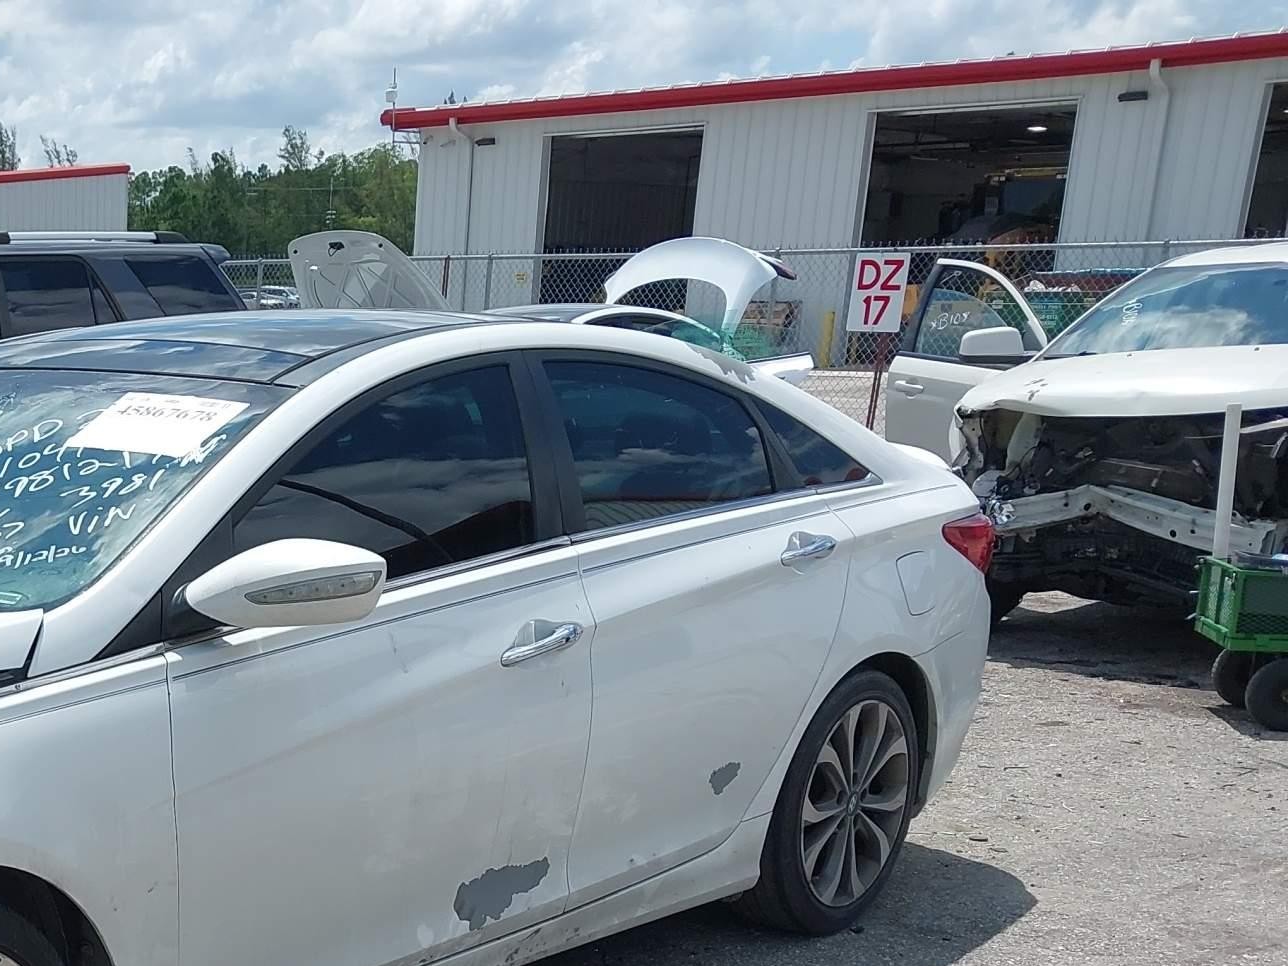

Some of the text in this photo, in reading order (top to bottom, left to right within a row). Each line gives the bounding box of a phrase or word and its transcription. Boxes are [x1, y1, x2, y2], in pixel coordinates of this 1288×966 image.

[857, 259, 905, 290] DZ
[862, 295, 891, 325] 17
[117, 405, 218, 421] 45867678
[60, 468, 167, 509] 3981
